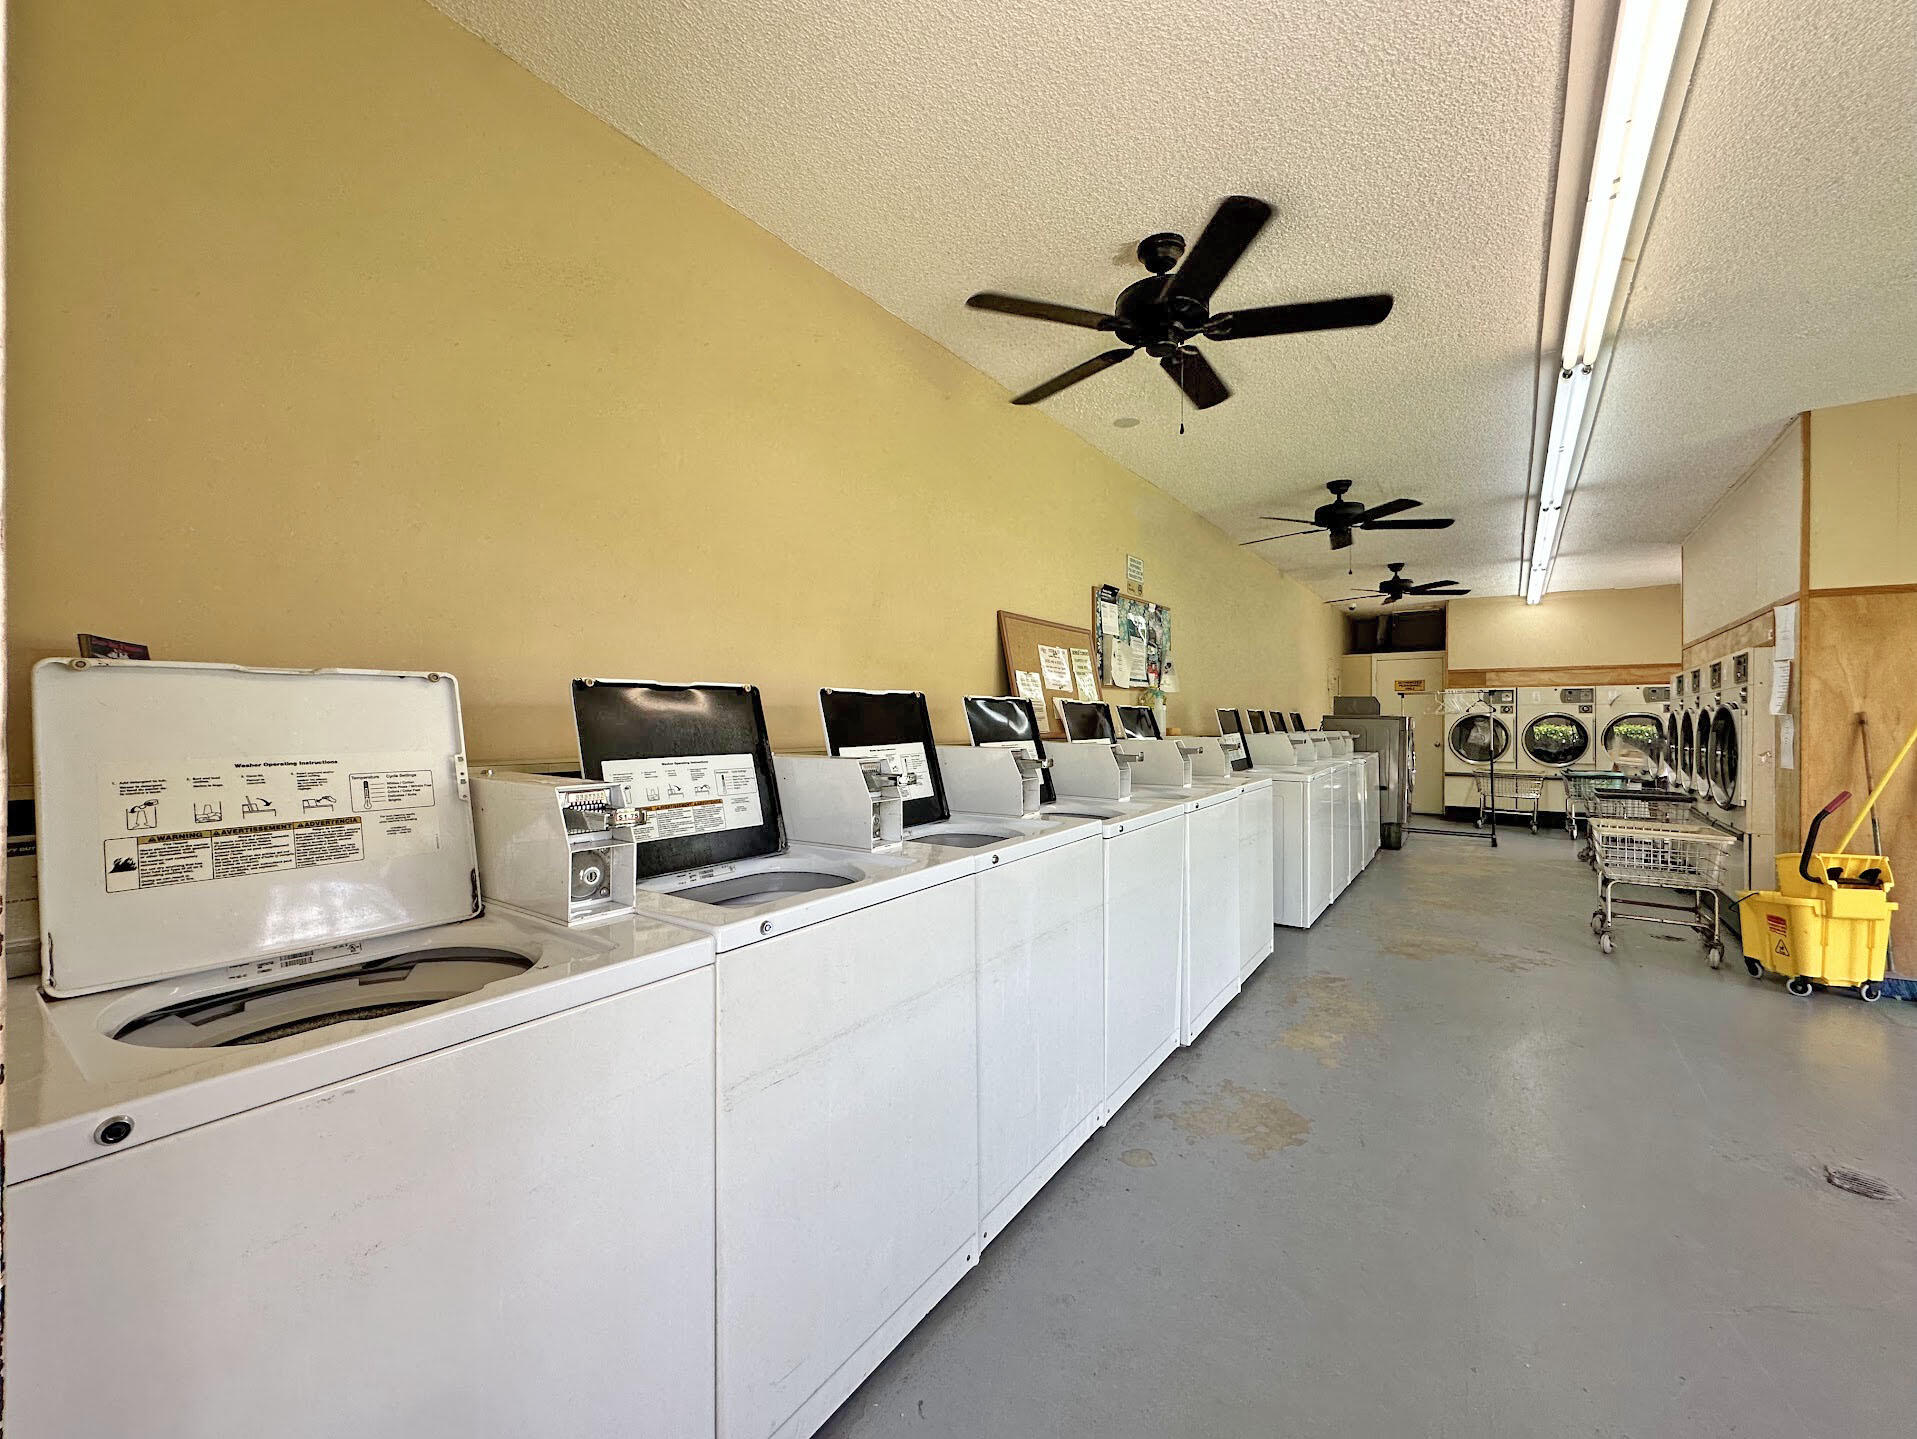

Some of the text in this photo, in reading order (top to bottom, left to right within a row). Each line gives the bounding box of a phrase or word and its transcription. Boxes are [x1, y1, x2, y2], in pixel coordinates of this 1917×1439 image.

[305, 818, 357, 827] ADVERTENCIA
[221, 824, 292, 835] AVERTISSEMENT
[157, 832, 203, 841] WARNING
